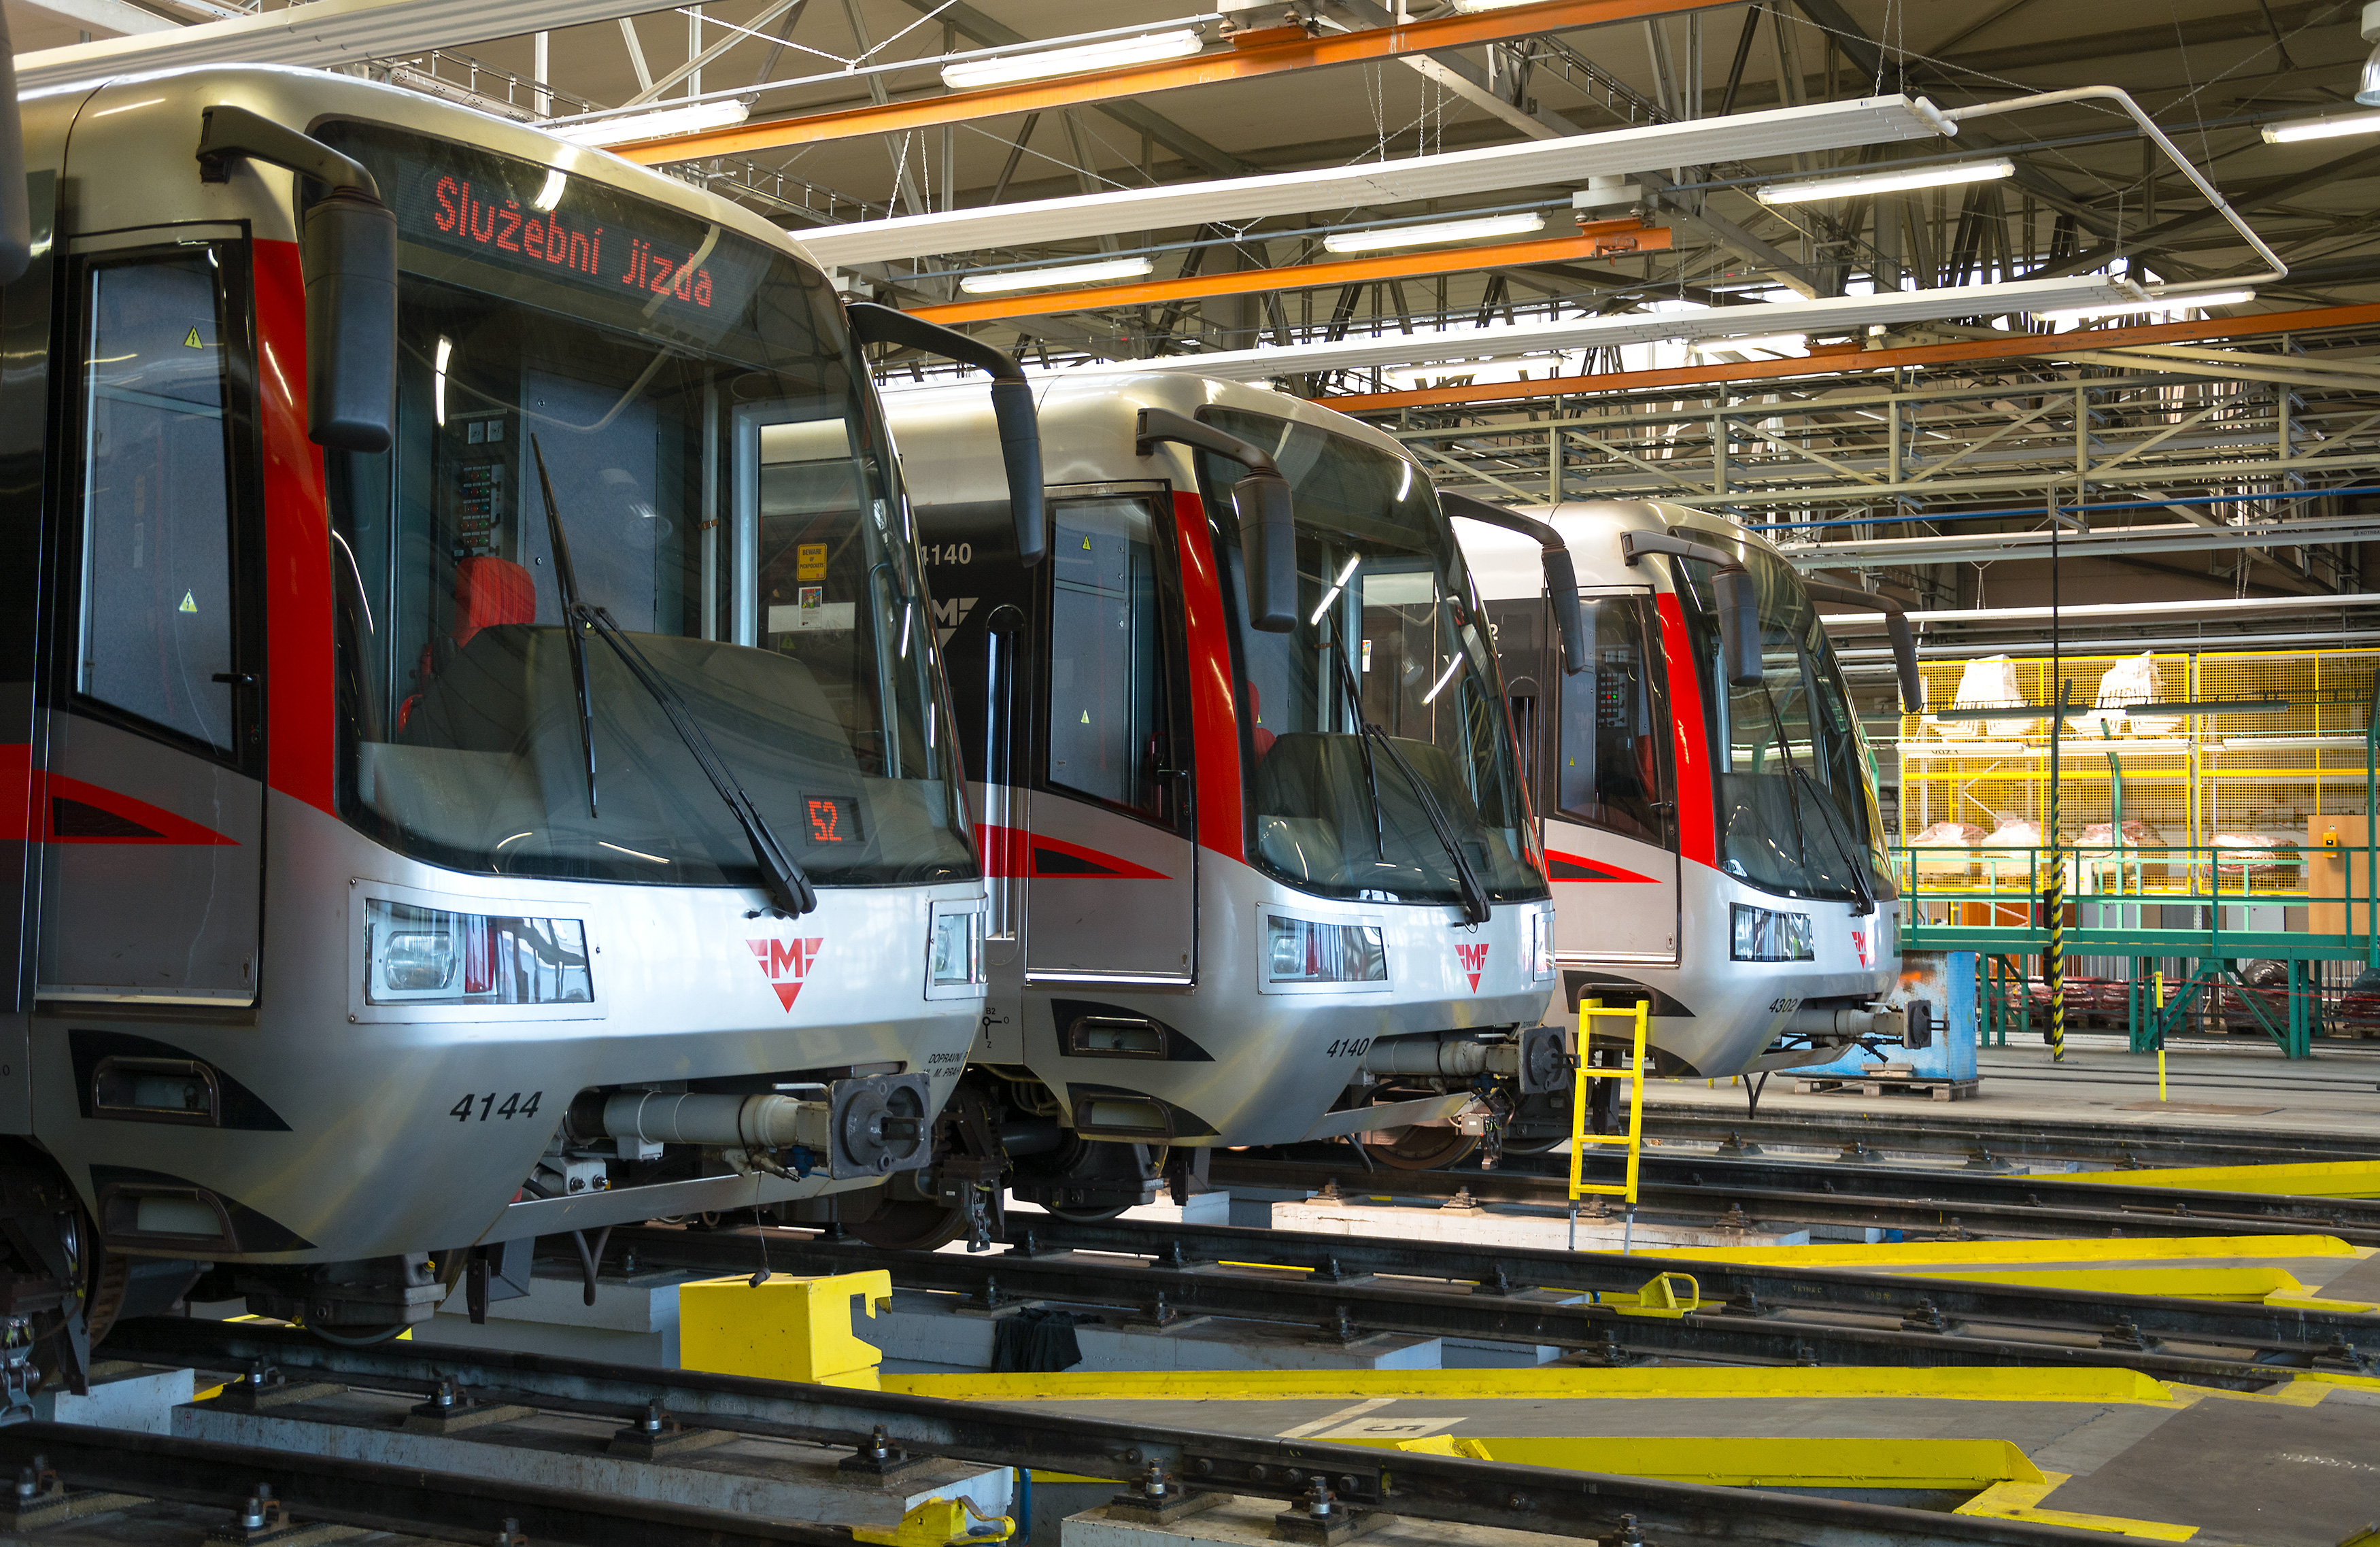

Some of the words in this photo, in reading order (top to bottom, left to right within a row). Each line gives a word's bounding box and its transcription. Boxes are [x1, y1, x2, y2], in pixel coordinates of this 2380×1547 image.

[435, 175, 603, 275] Služební
[622, 239, 713, 307] jízda
[808, 800, 842, 841] 52
[770, 938, 804, 979] M
[1465, 943, 1481, 971] M
[1769, 998, 1798, 1013] 4302
[928, 1049, 964, 1064] DOPRAVNÍ
[987, 1040, 992, 1049] Z
[1326, 1038, 1370, 1057] 4140
[449, 1091, 543, 1122] 4144
